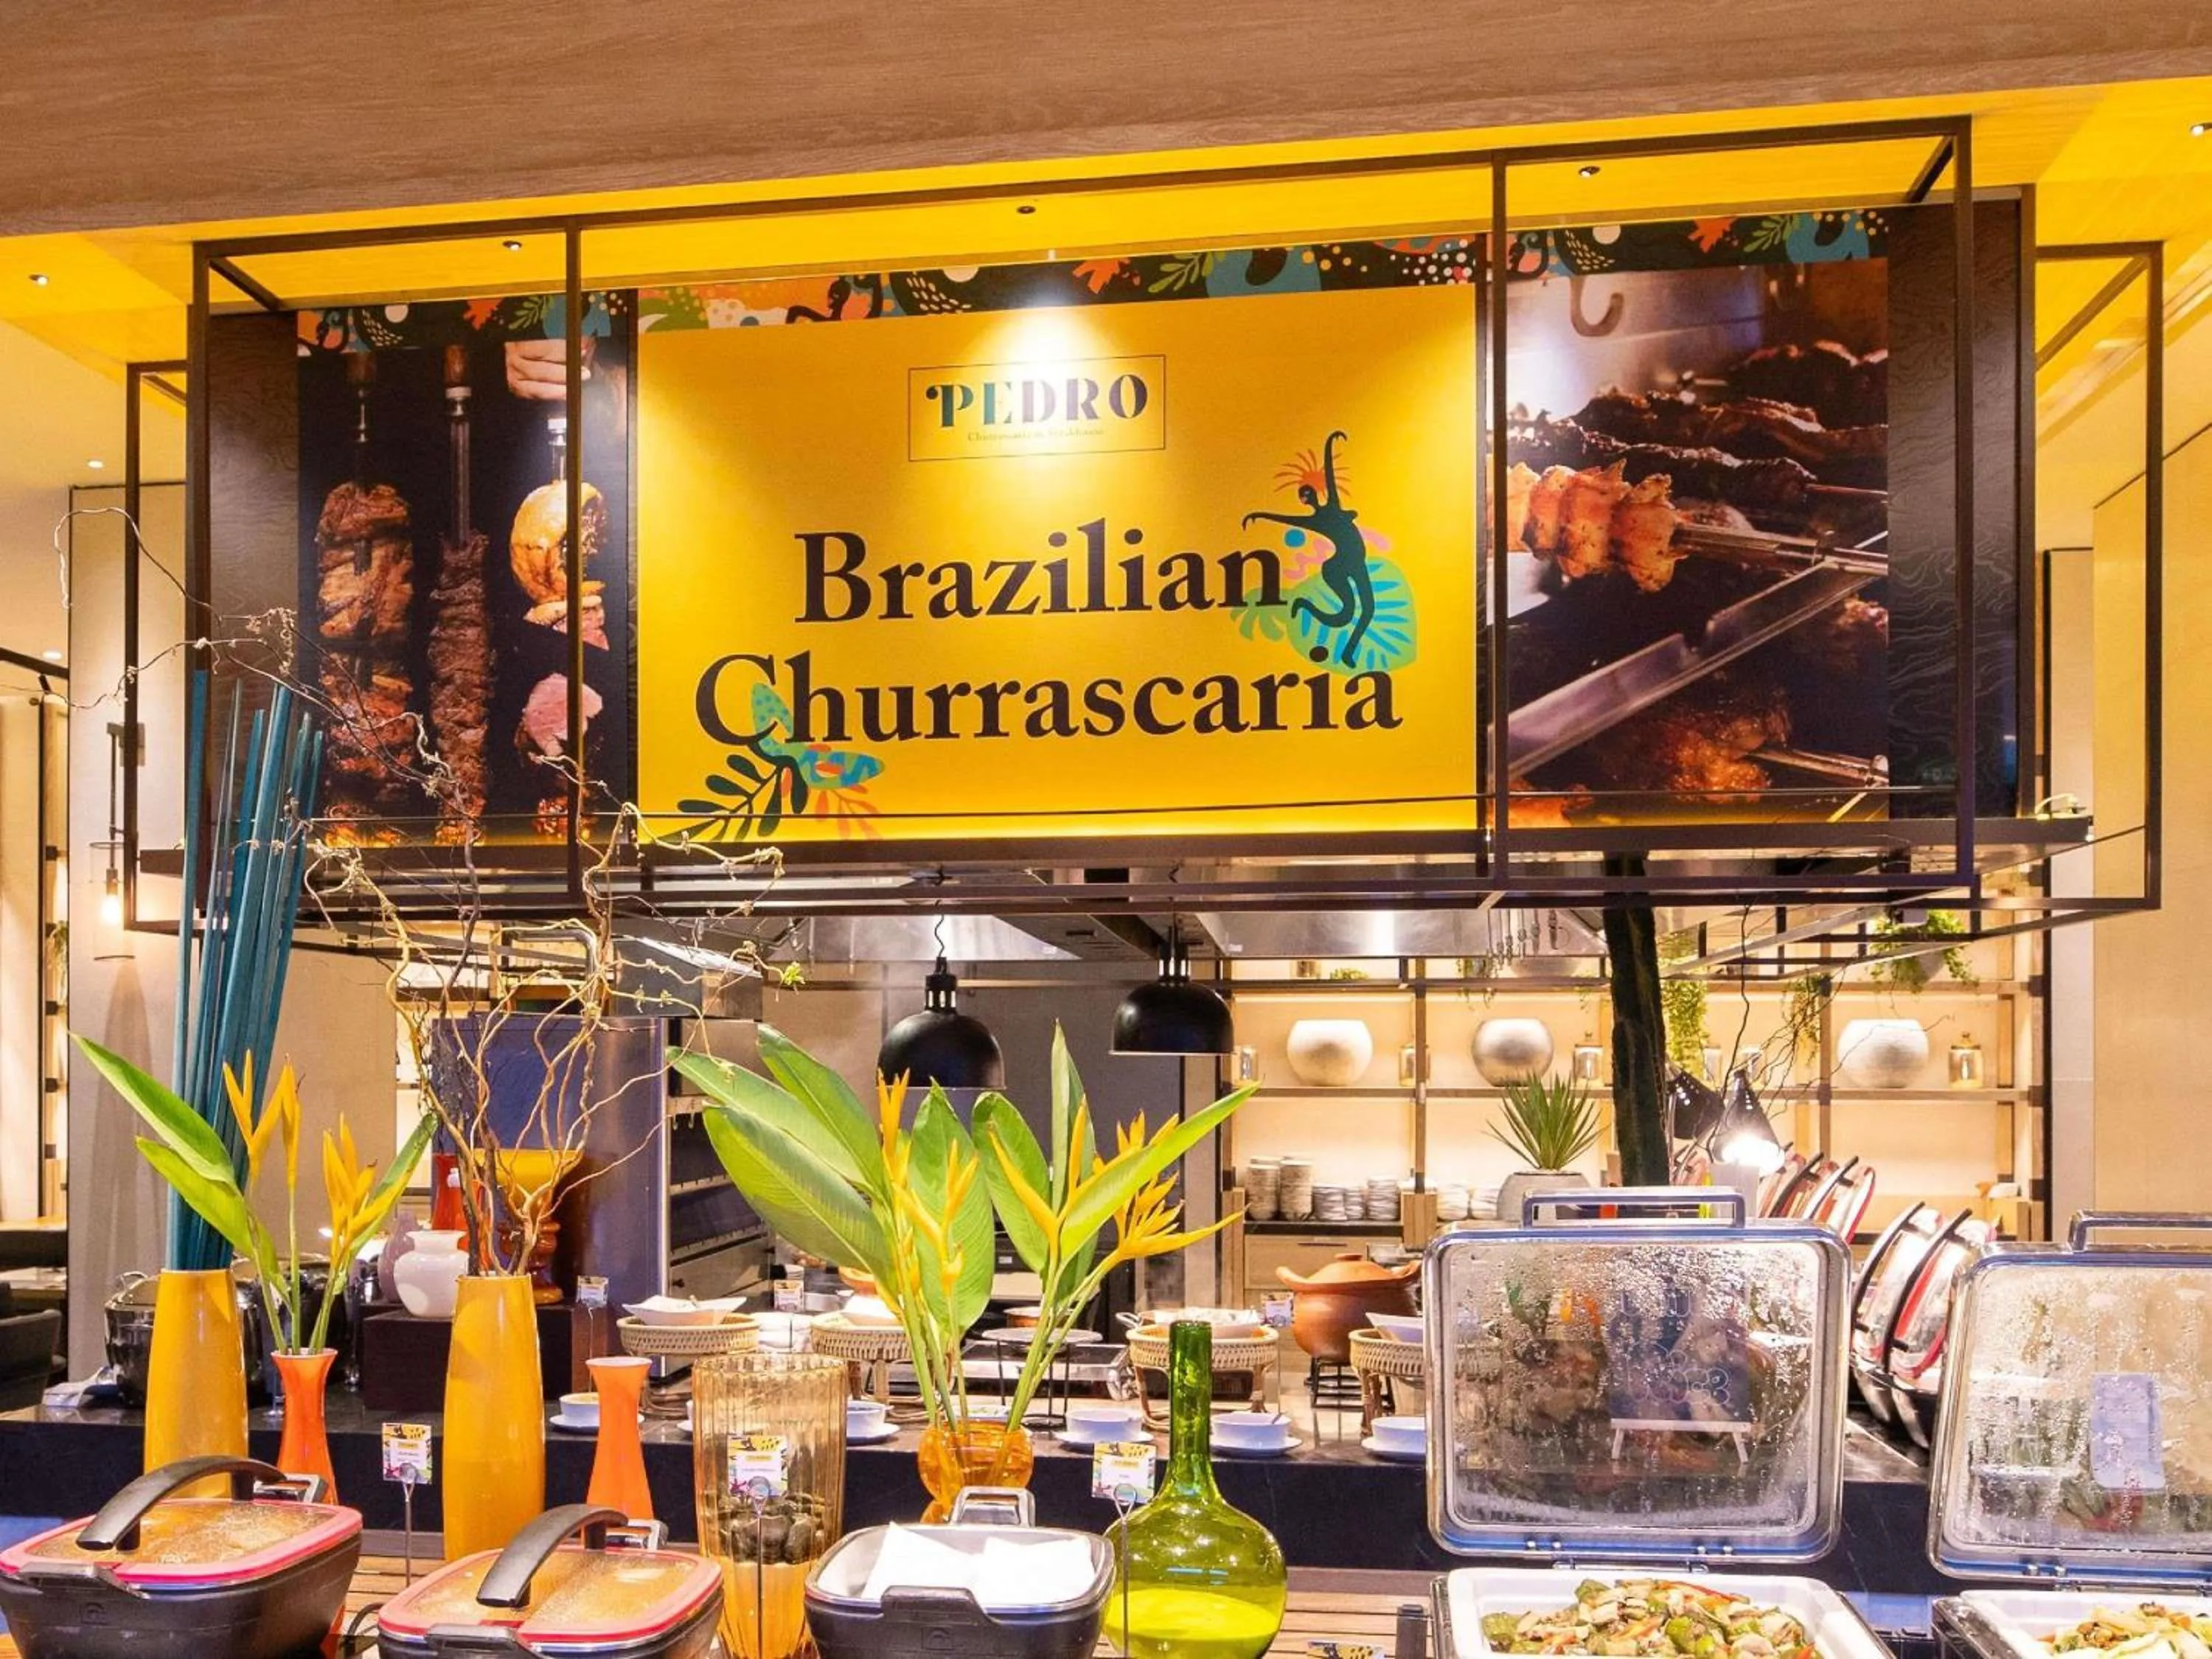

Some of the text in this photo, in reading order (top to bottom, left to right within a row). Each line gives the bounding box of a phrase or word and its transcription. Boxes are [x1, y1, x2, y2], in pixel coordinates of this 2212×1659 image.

[925, 374, 1148, 428] PEDRO
[795, 518, 1287, 622] Brazilian
[695, 647, 1402, 745] Churrascaria
